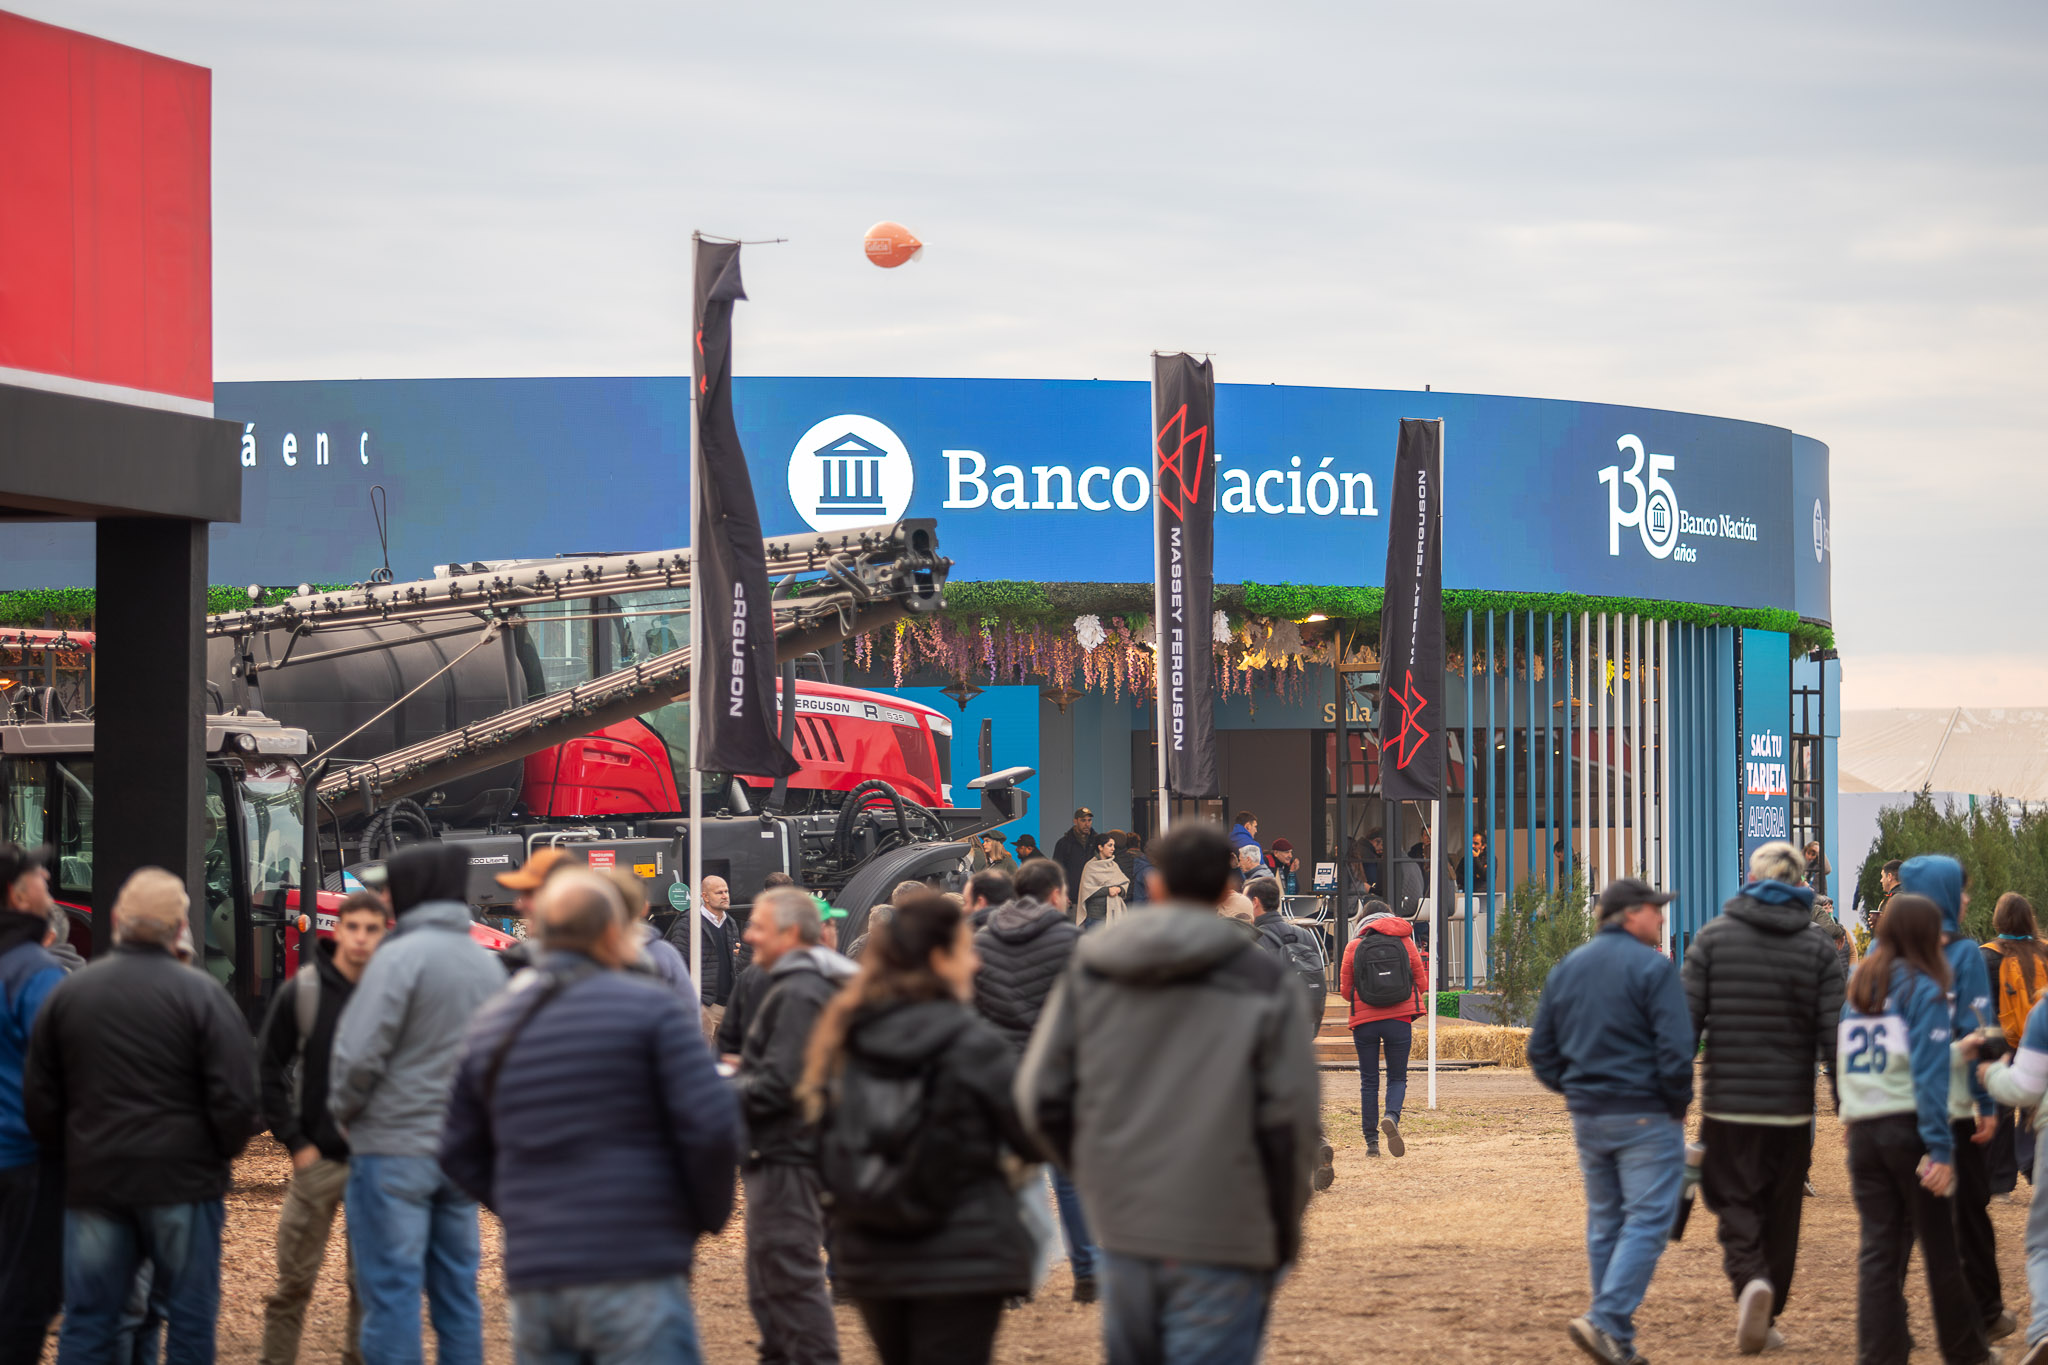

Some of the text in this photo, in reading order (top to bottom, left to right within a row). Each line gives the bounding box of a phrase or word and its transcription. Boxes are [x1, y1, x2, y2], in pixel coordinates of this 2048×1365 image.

[941, 449, 1379, 517] Banco ación
[1679, 509, 1758, 542] Banco Nación
[1673, 542, 1697, 563] años
[1170, 527, 1184, 751] MASSEY FERGUSON
[795, 699, 850, 713] ERGUSON
[863, 704, 879, 719] R
[1323, 701, 1373, 723] Sla
[1750, 729, 1783, 758] SACÁ TU
[1745, 762, 1788, 801] TARJETA
[1747, 805, 1787, 838] AHORA
[1847, 1024, 1887, 1074] 26
